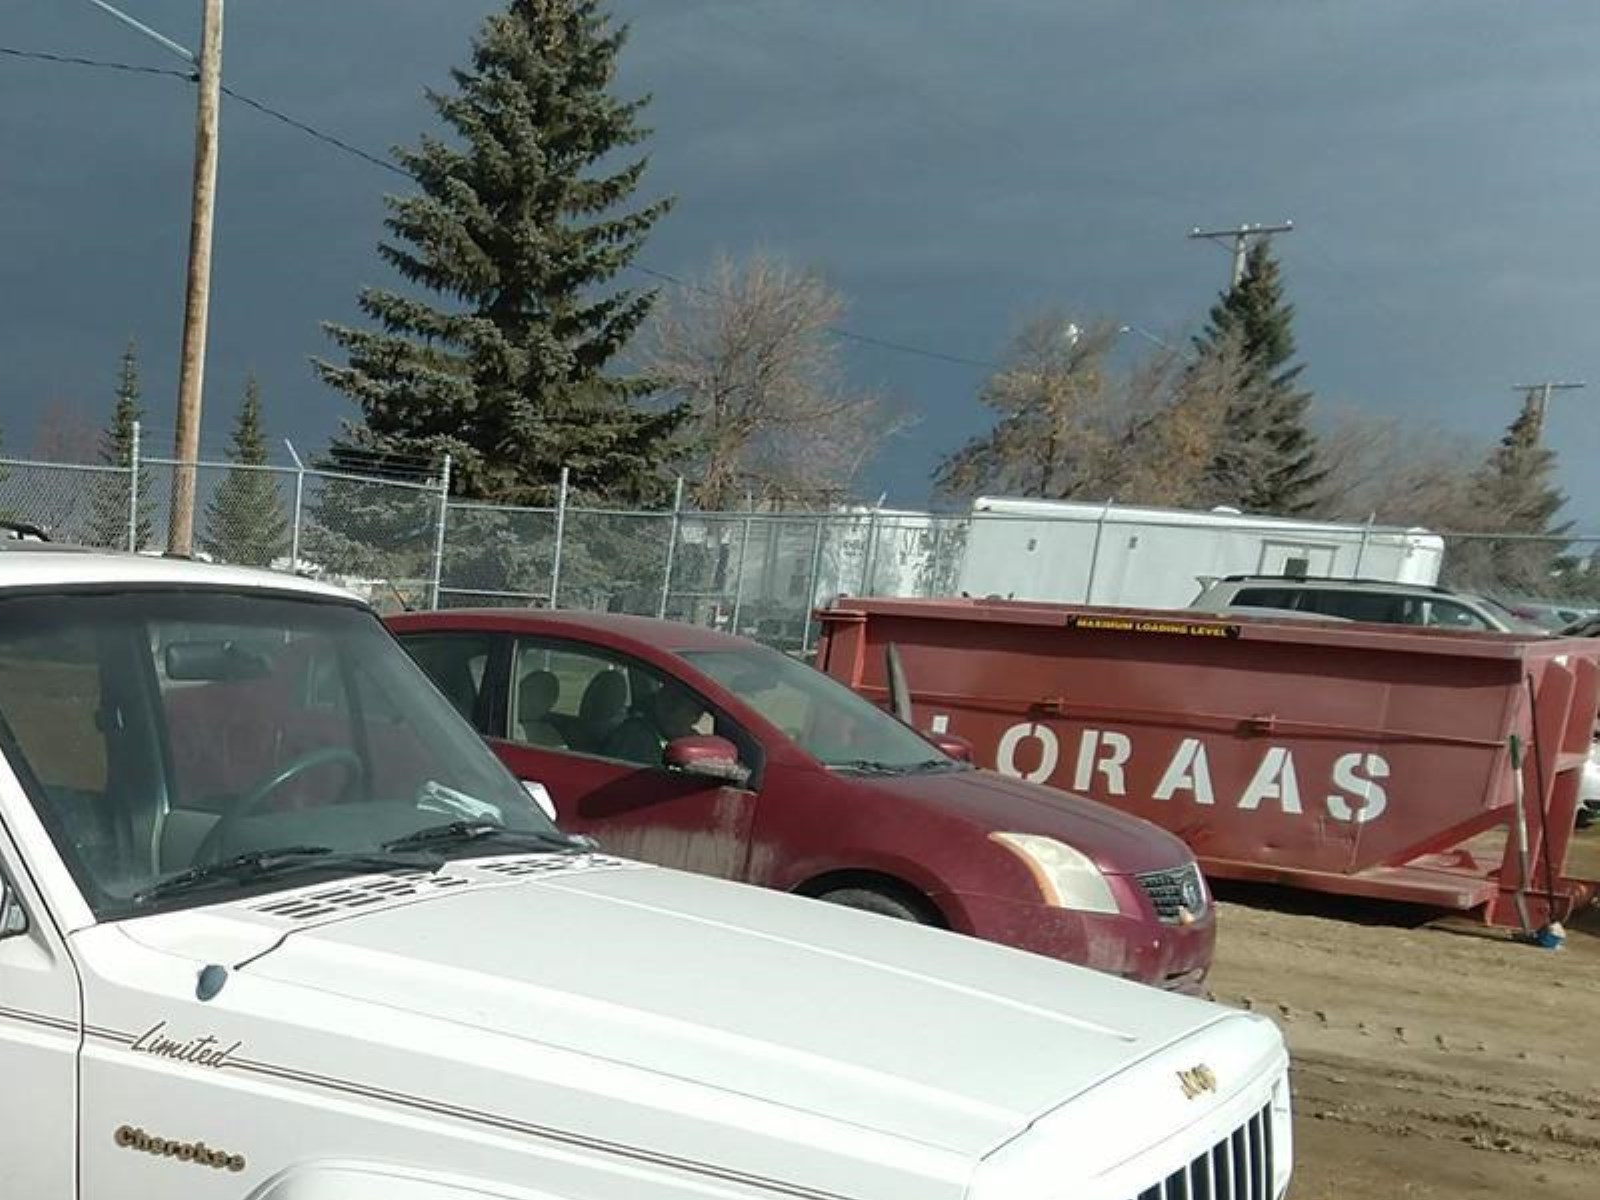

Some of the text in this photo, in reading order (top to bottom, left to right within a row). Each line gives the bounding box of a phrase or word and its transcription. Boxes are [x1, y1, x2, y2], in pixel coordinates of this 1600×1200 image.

[1076, 618, 1228, 637] MAXIMUM LOADING LEVEL
[932, 715, 1391, 824] ORAAS
[131, 1020, 242, 1069] Limited
[114, 1124, 246, 1172] Cherokee
